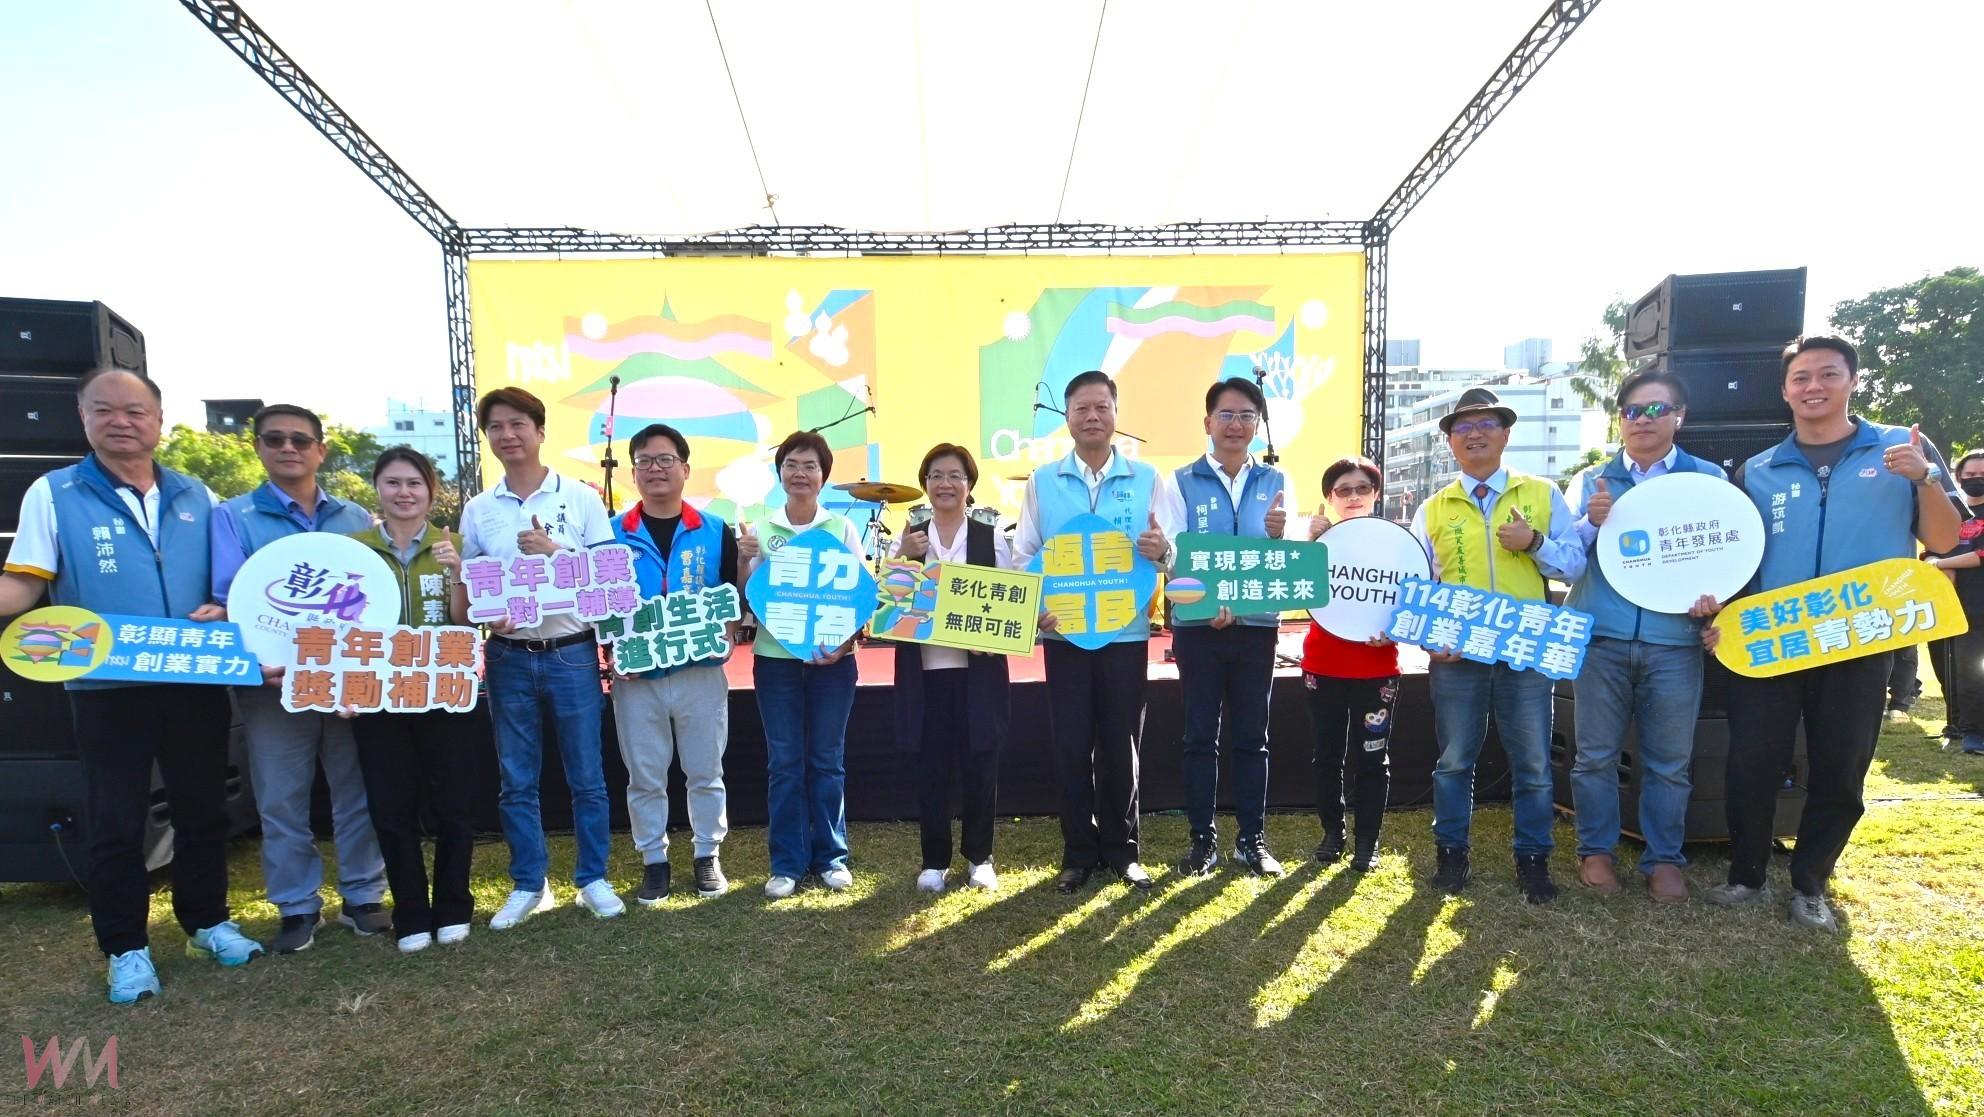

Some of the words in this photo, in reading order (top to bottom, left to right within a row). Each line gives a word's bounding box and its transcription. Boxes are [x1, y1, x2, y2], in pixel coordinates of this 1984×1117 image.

[1196, 505, 1208, 534] 柯呈
[1658, 519, 1721, 537] 彰化縣政府
[91, 526, 119, 574] 賴沛然
[1660, 529, 1741, 553] 青年發展處
[465, 549, 632, 598] 青年創業
[768, 546, 861, 590] 青力
[1053, 580, 1097, 589] CHANGHUA
[283, 562, 367, 622] 彰化
[472, 585, 638, 625] 一對一輔導
[776, 591, 820, 600] CHANGHUA
[950, 577, 1027, 604] 彰化青創
[1216, 578, 1316, 601] 創造未來
[1329, 584, 1397, 606] YOUTH
[1739, 581, 1873, 636] 美好彰化
[765, 601, 856, 647] 青為
[945, 611, 1023, 640] 無限可能
[1403, 581, 1588, 643] 114彰化青年
[117, 624, 235, 650] 彰顯青年
[292, 626, 477, 668] 青年創業
[616, 621, 726, 671] 進行式
[1390, 609, 1580, 674] 創業嘉年華
[131, 651, 250, 676] 創業實力
[290, 669, 473, 709] 獎勵補助
